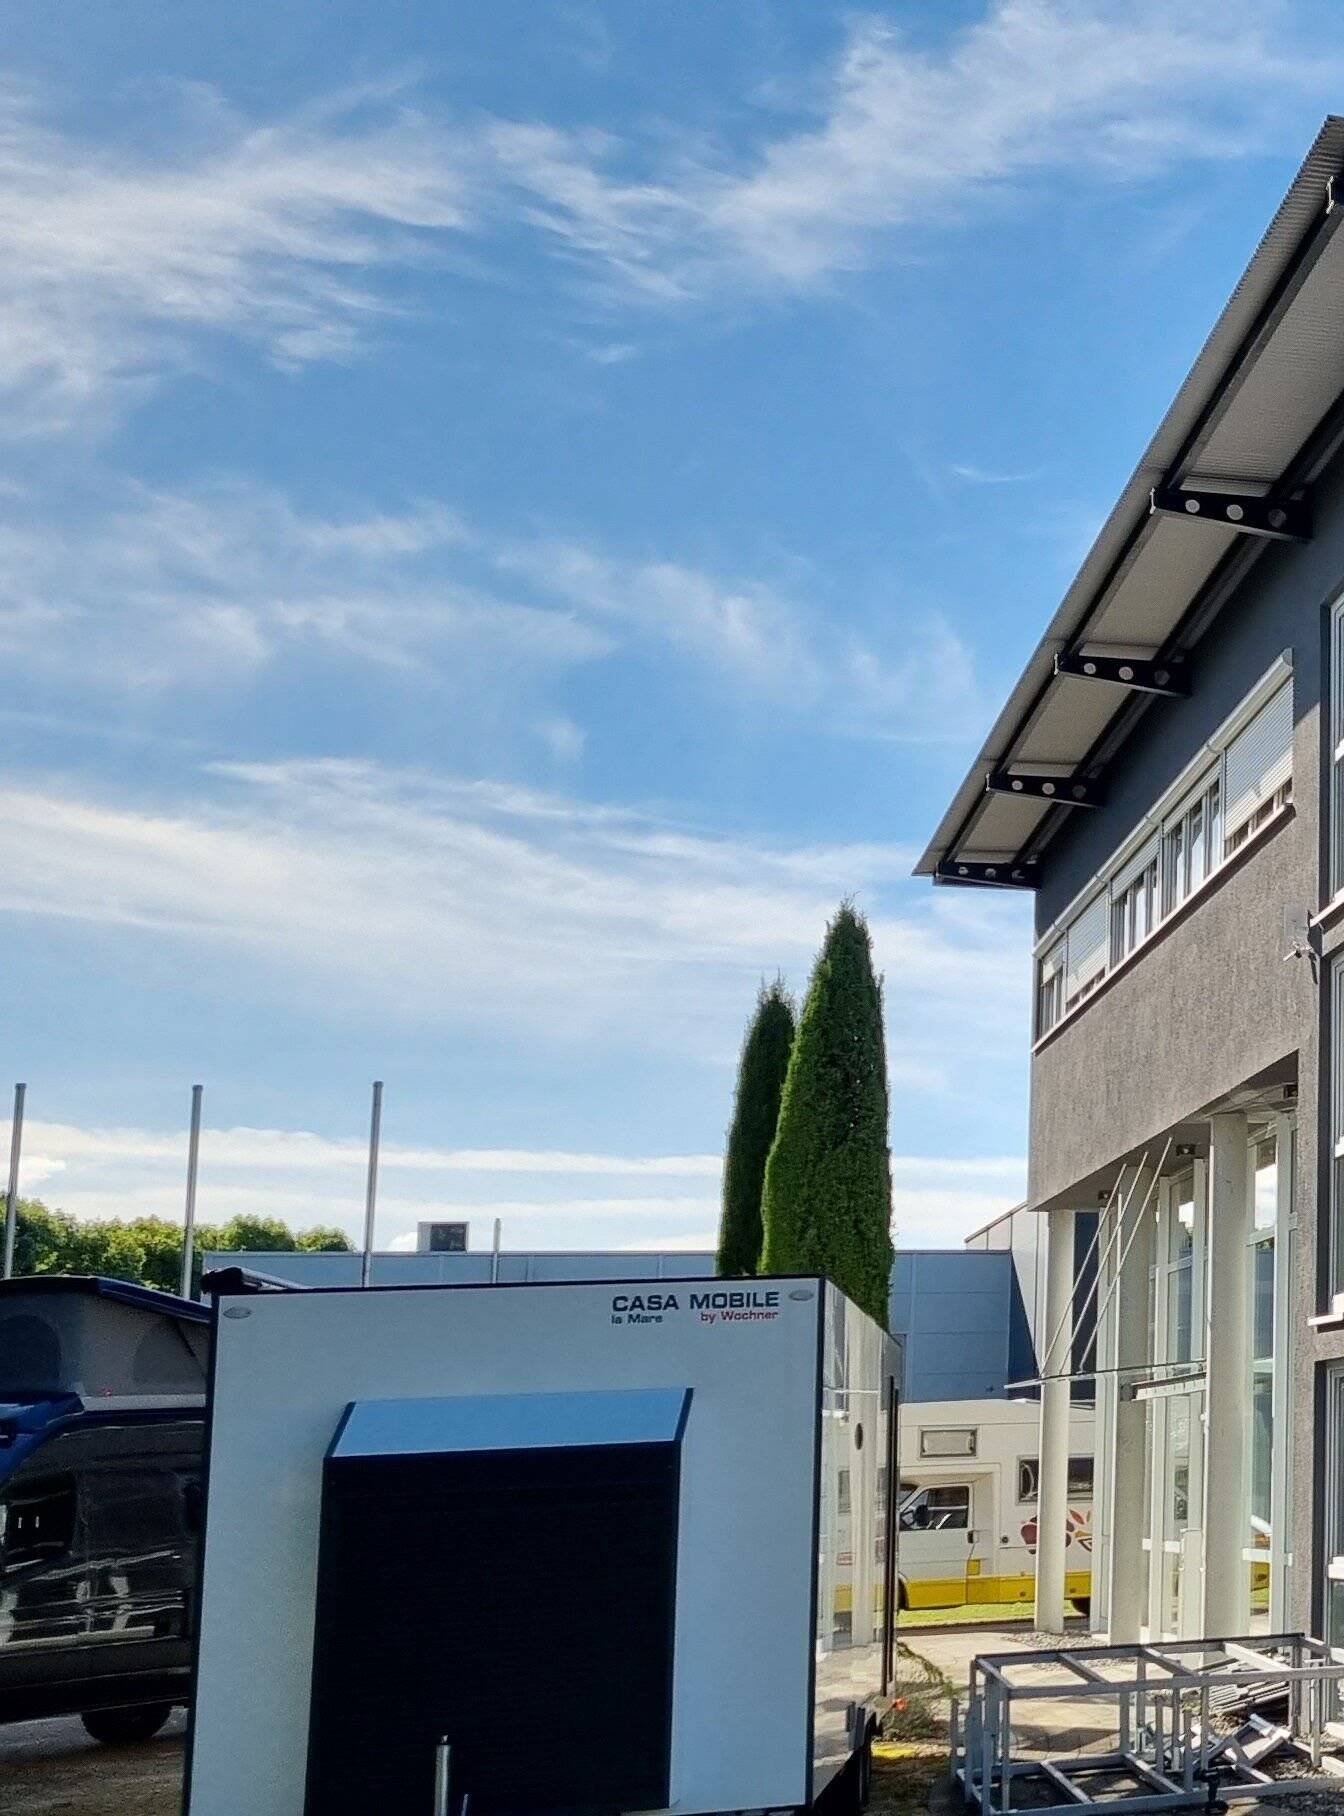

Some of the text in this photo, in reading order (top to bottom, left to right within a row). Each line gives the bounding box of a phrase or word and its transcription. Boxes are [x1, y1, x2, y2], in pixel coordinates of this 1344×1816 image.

[612, 1291, 779, 1312] CASA MOBILE
[627, 1313, 663, 1324] Mare
[700, 1312, 716, 1324] by
